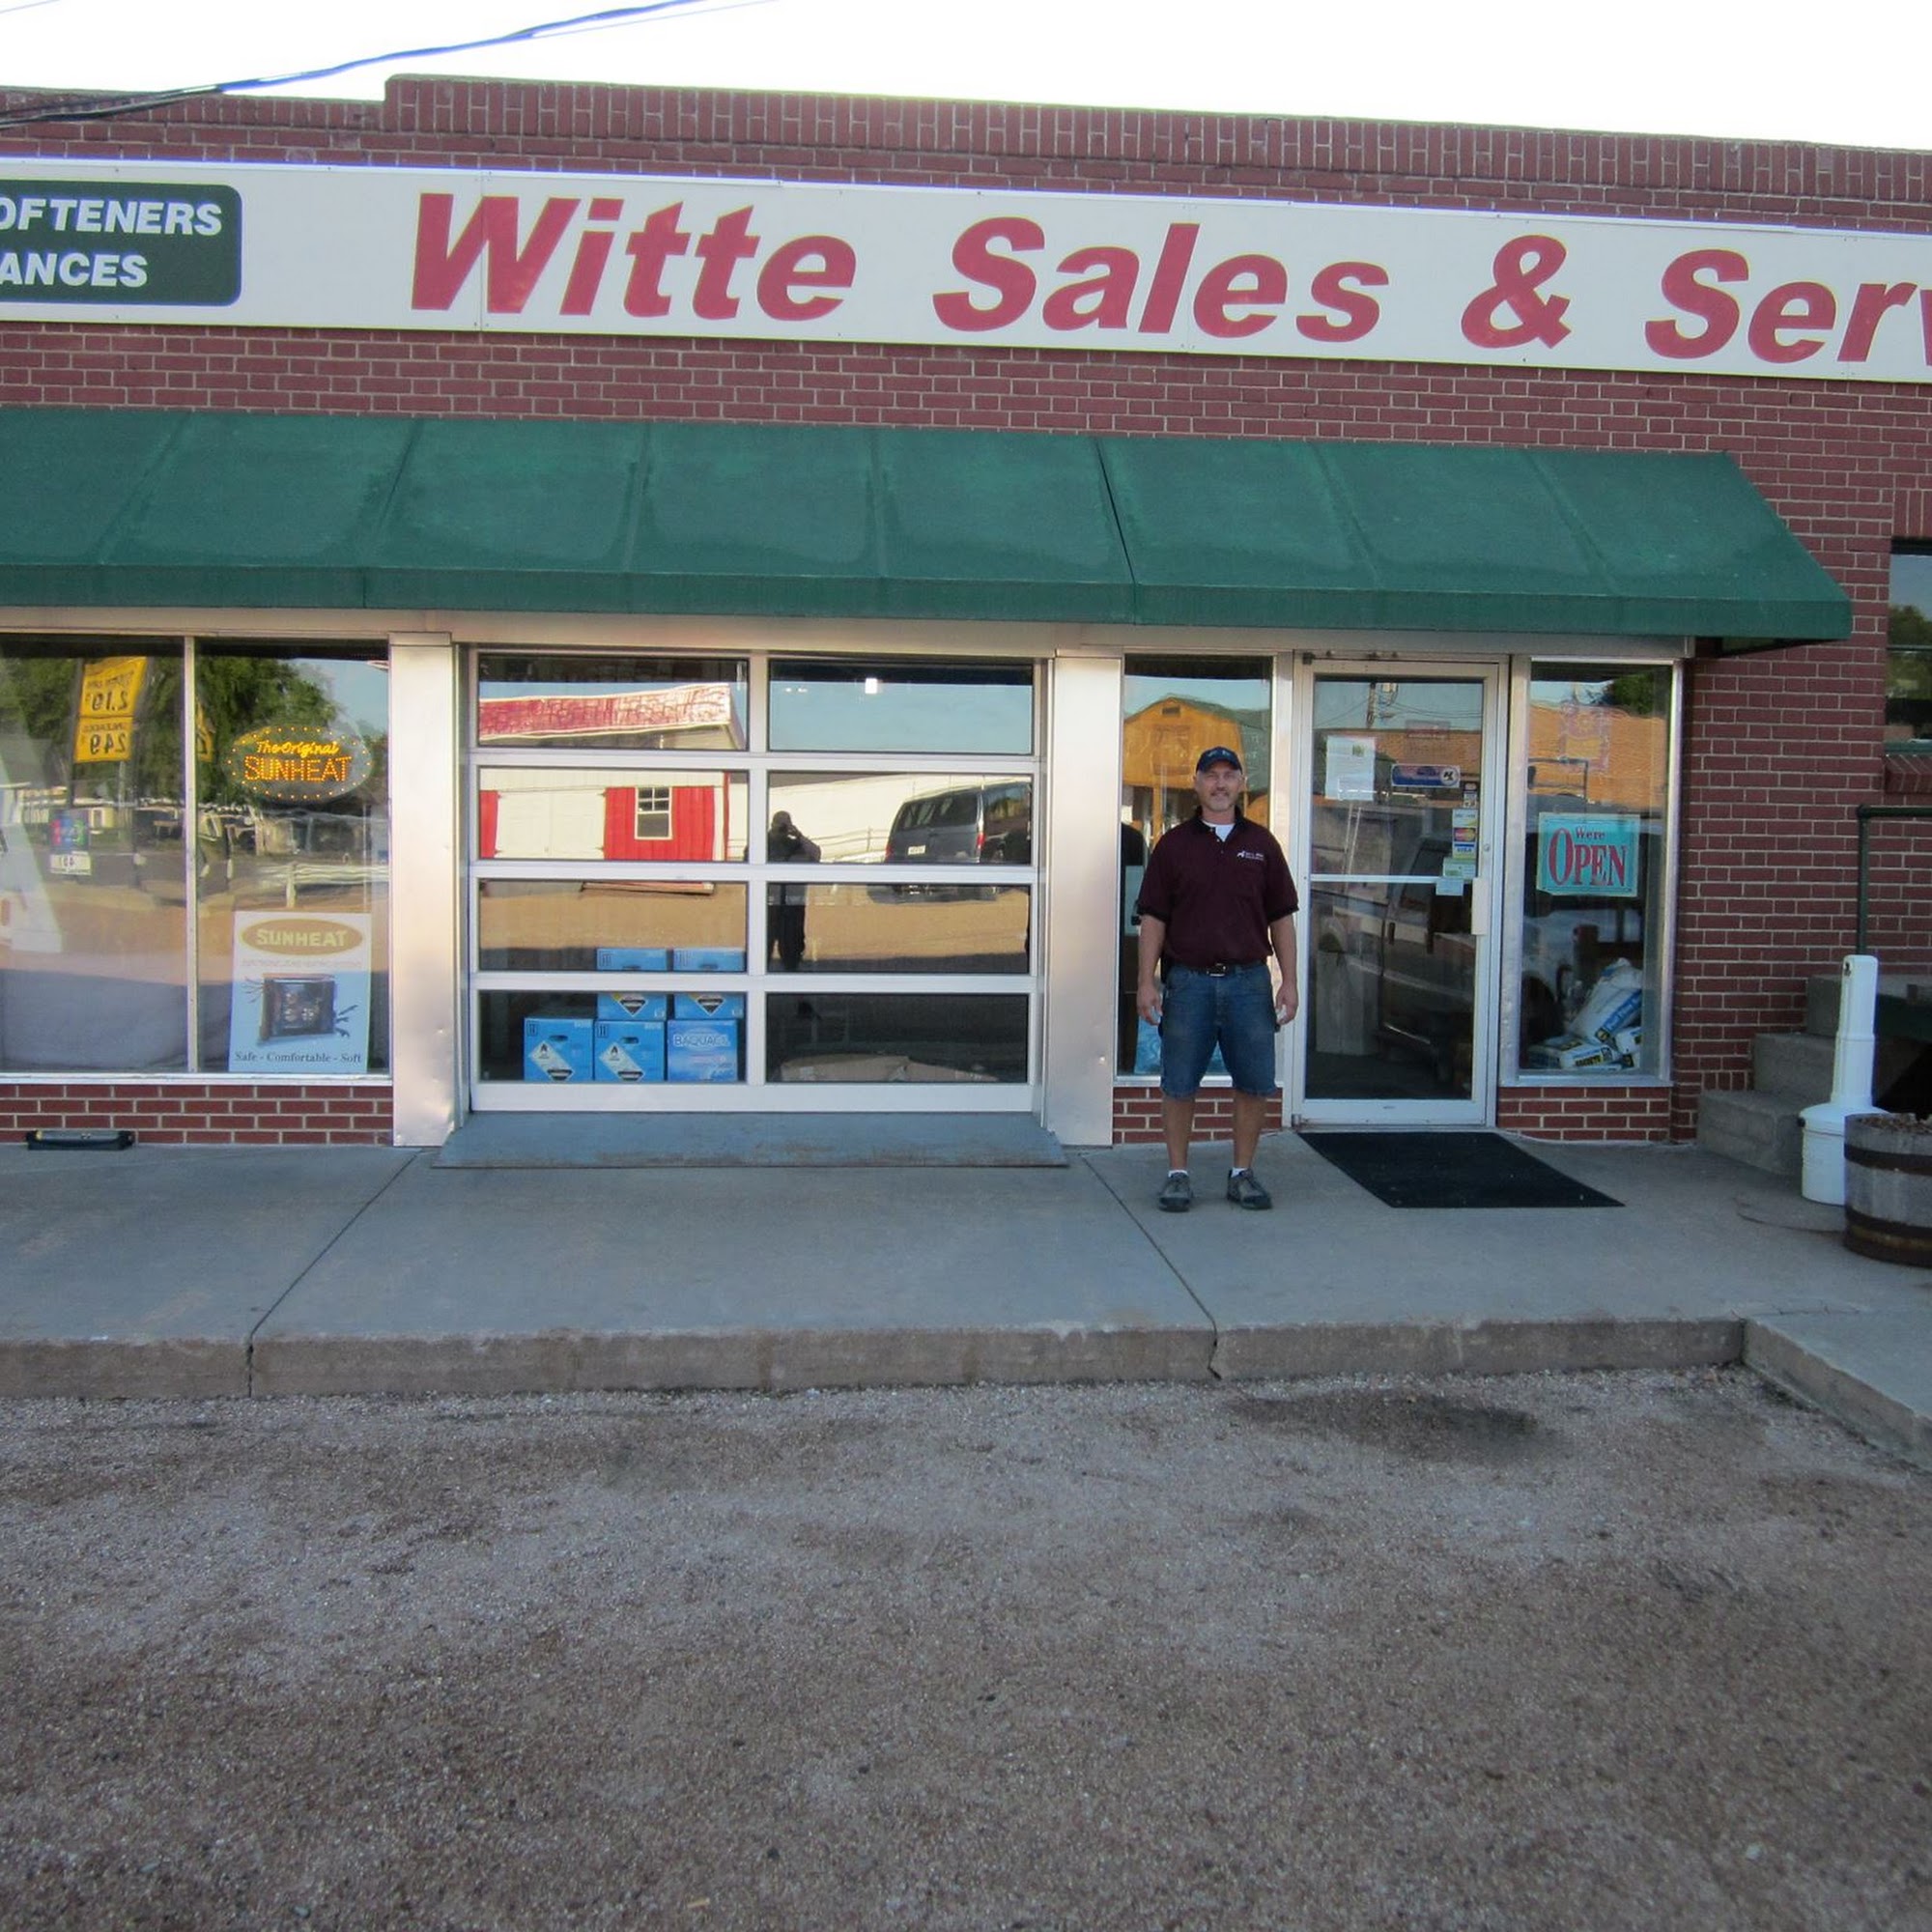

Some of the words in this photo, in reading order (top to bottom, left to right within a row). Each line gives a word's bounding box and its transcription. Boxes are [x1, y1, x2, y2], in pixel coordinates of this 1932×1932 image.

[412, 193, 856, 322] Witte
[934, 218, 1388, 342] Sales
[1462, 236, 1571, 348] &
[1645, 249, 1932, 366] Ser
[256, 740, 280, 754] The
[279, 740, 340, 758] Original
[244, 754, 353, 782] SUNHEAT
[1548, 827, 1628, 887] OPEN
[255, 927, 348, 948] SUNHEAT
[235, 1051, 257, 1062] Safe
[267, 1051, 330, 1063] Comfortable
